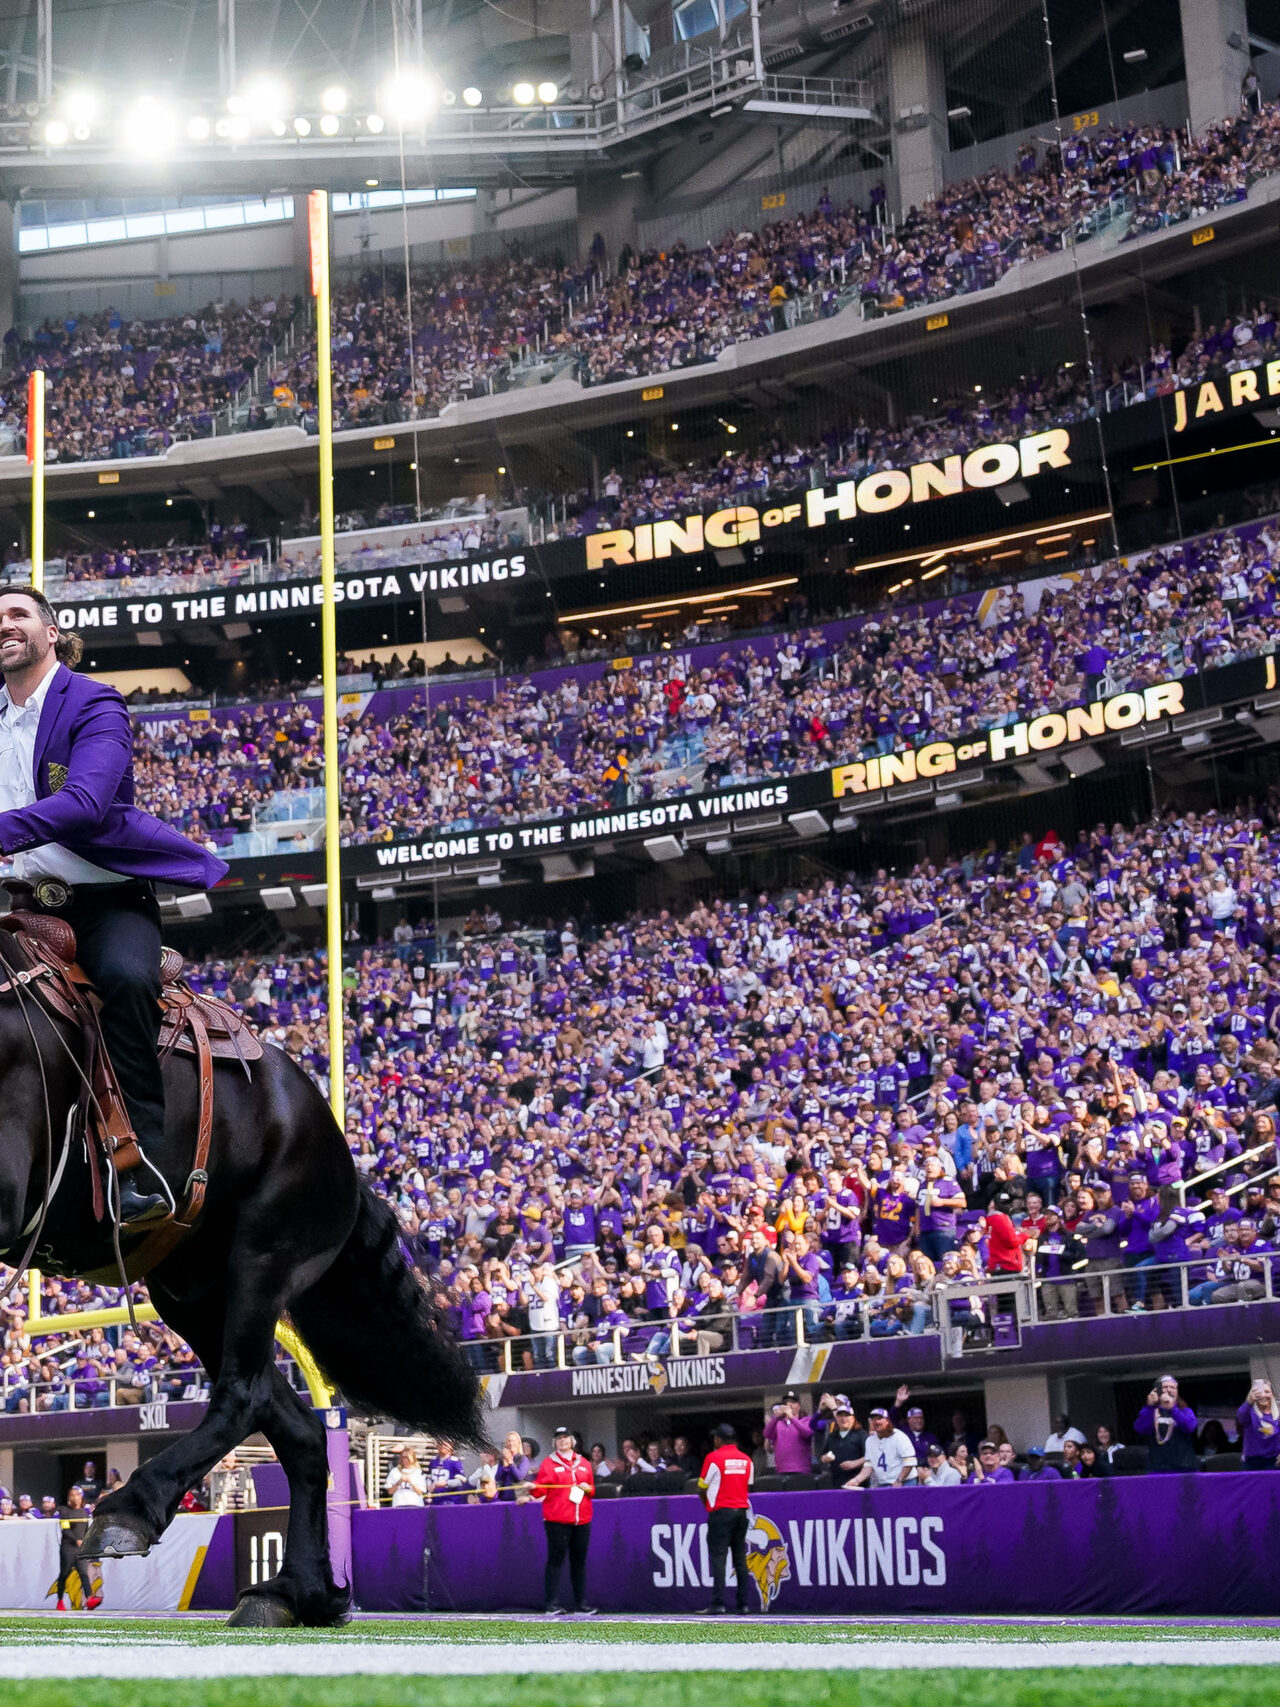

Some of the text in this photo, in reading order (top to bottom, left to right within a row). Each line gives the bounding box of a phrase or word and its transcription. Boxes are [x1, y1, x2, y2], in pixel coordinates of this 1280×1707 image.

[585, 428, 1071, 570] RING OF HONOR
[54, 555, 527, 630] OME TO THE MINNESOTA VIKINGS
[832, 681, 1185, 798] RING OF HONOR
[377, 785, 789, 866] WELCOME TO THE MINNESOTA VIKINGS
[573, 1357, 726, 1396] MINNESOTA VIKINGS
[140, 1405, 169, 1430] SKOL
[877, 1452, 888, 1472] 4
[788, 1516, 947, 1587] VIKINGS
